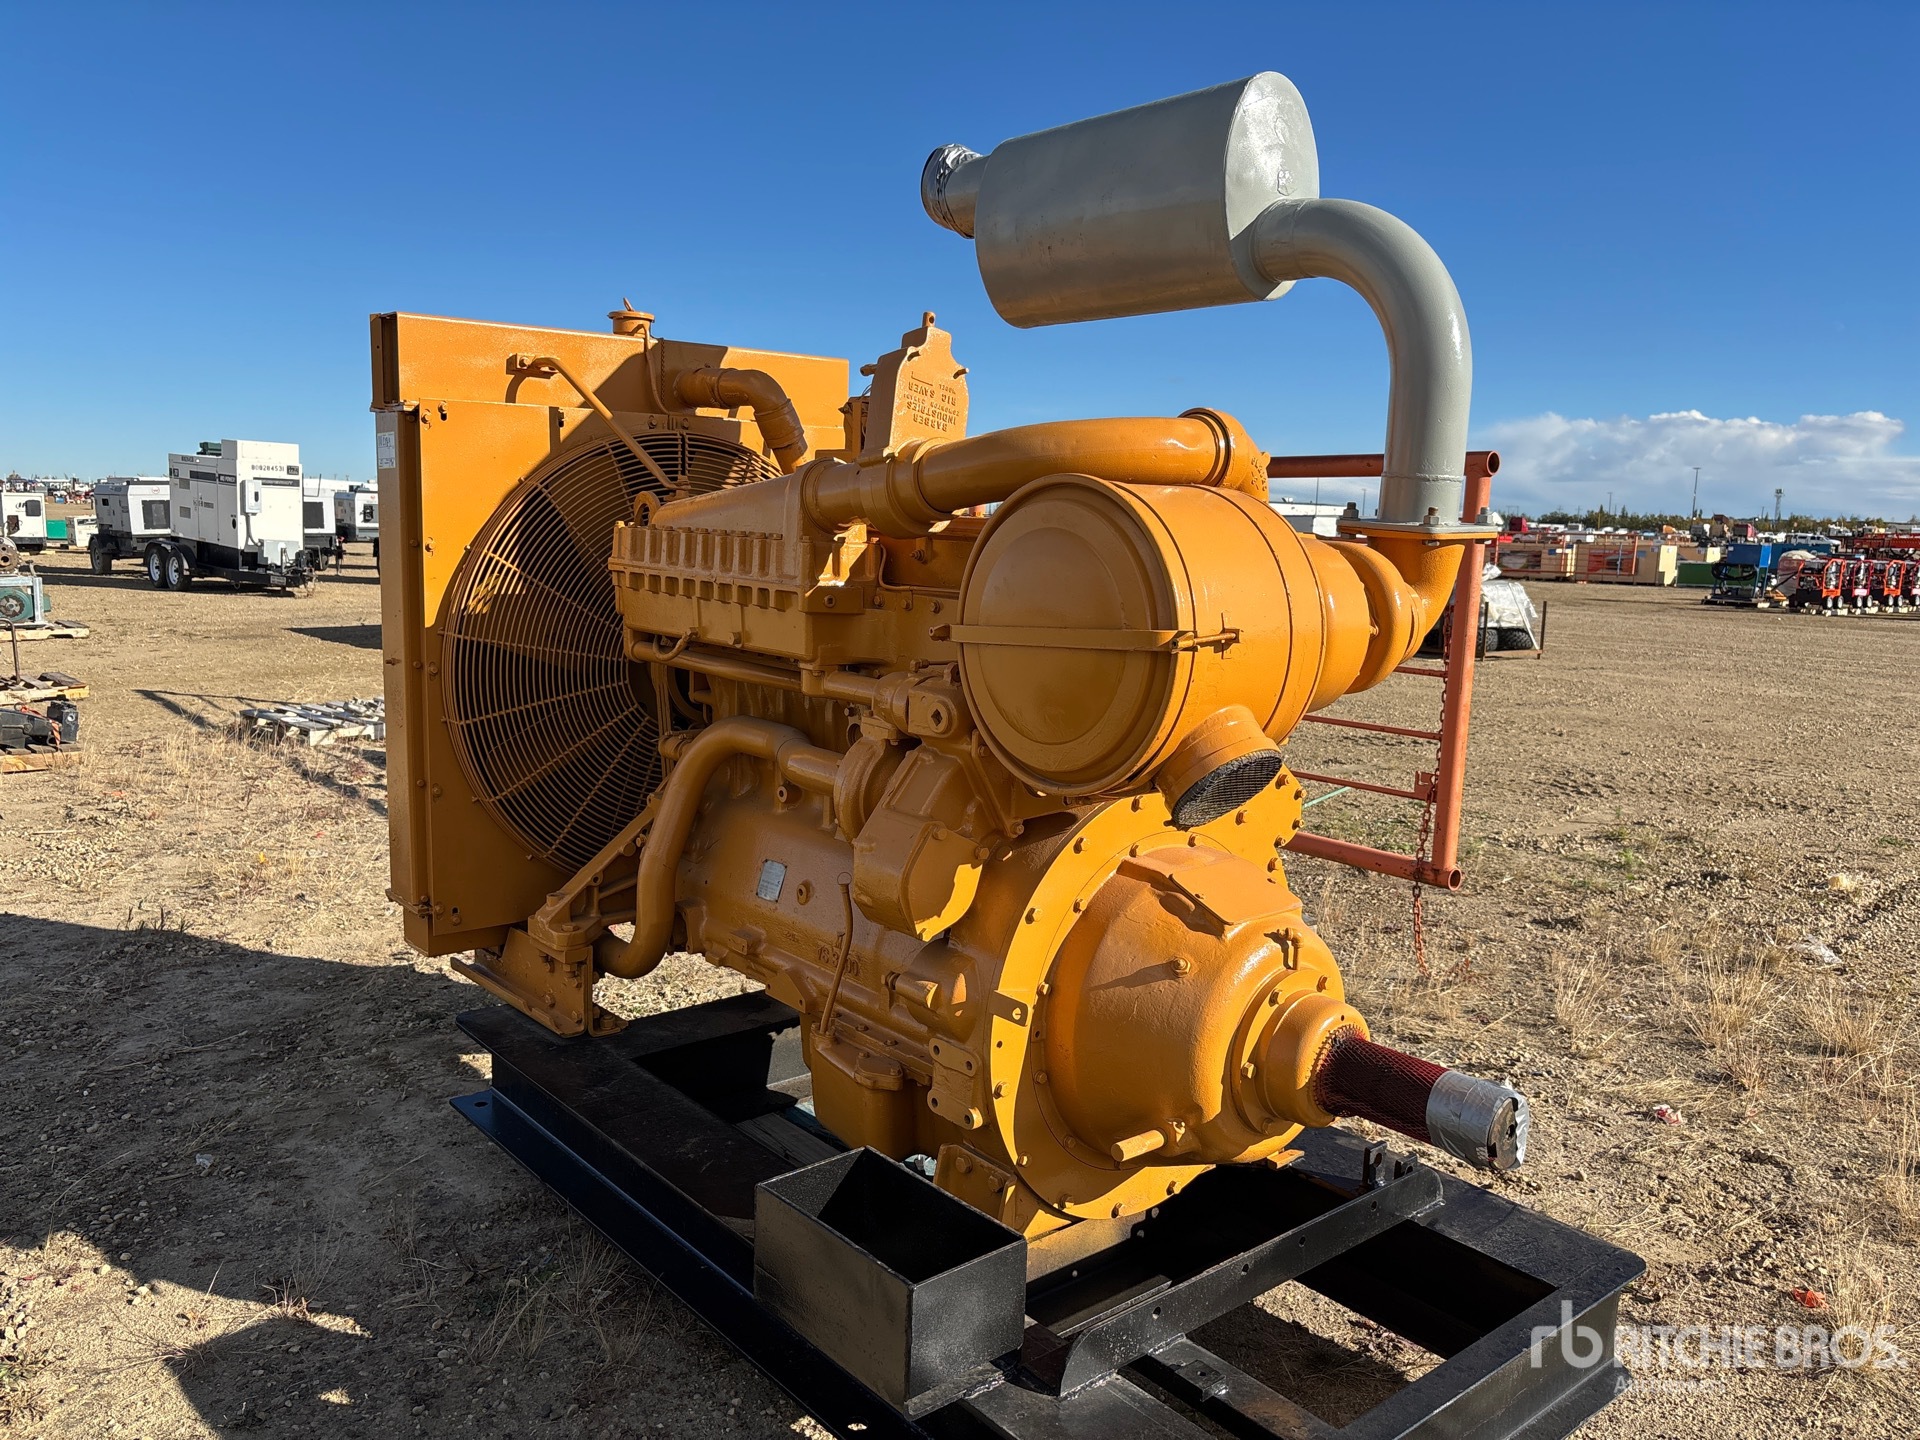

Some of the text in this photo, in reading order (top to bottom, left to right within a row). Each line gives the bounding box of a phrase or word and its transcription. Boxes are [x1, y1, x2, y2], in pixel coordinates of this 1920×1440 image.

[908, 381, 936, 398] SAVER
[906, 401, 956, 426] INDUSTRIES
[912, 413, 948, 433] BARBER
